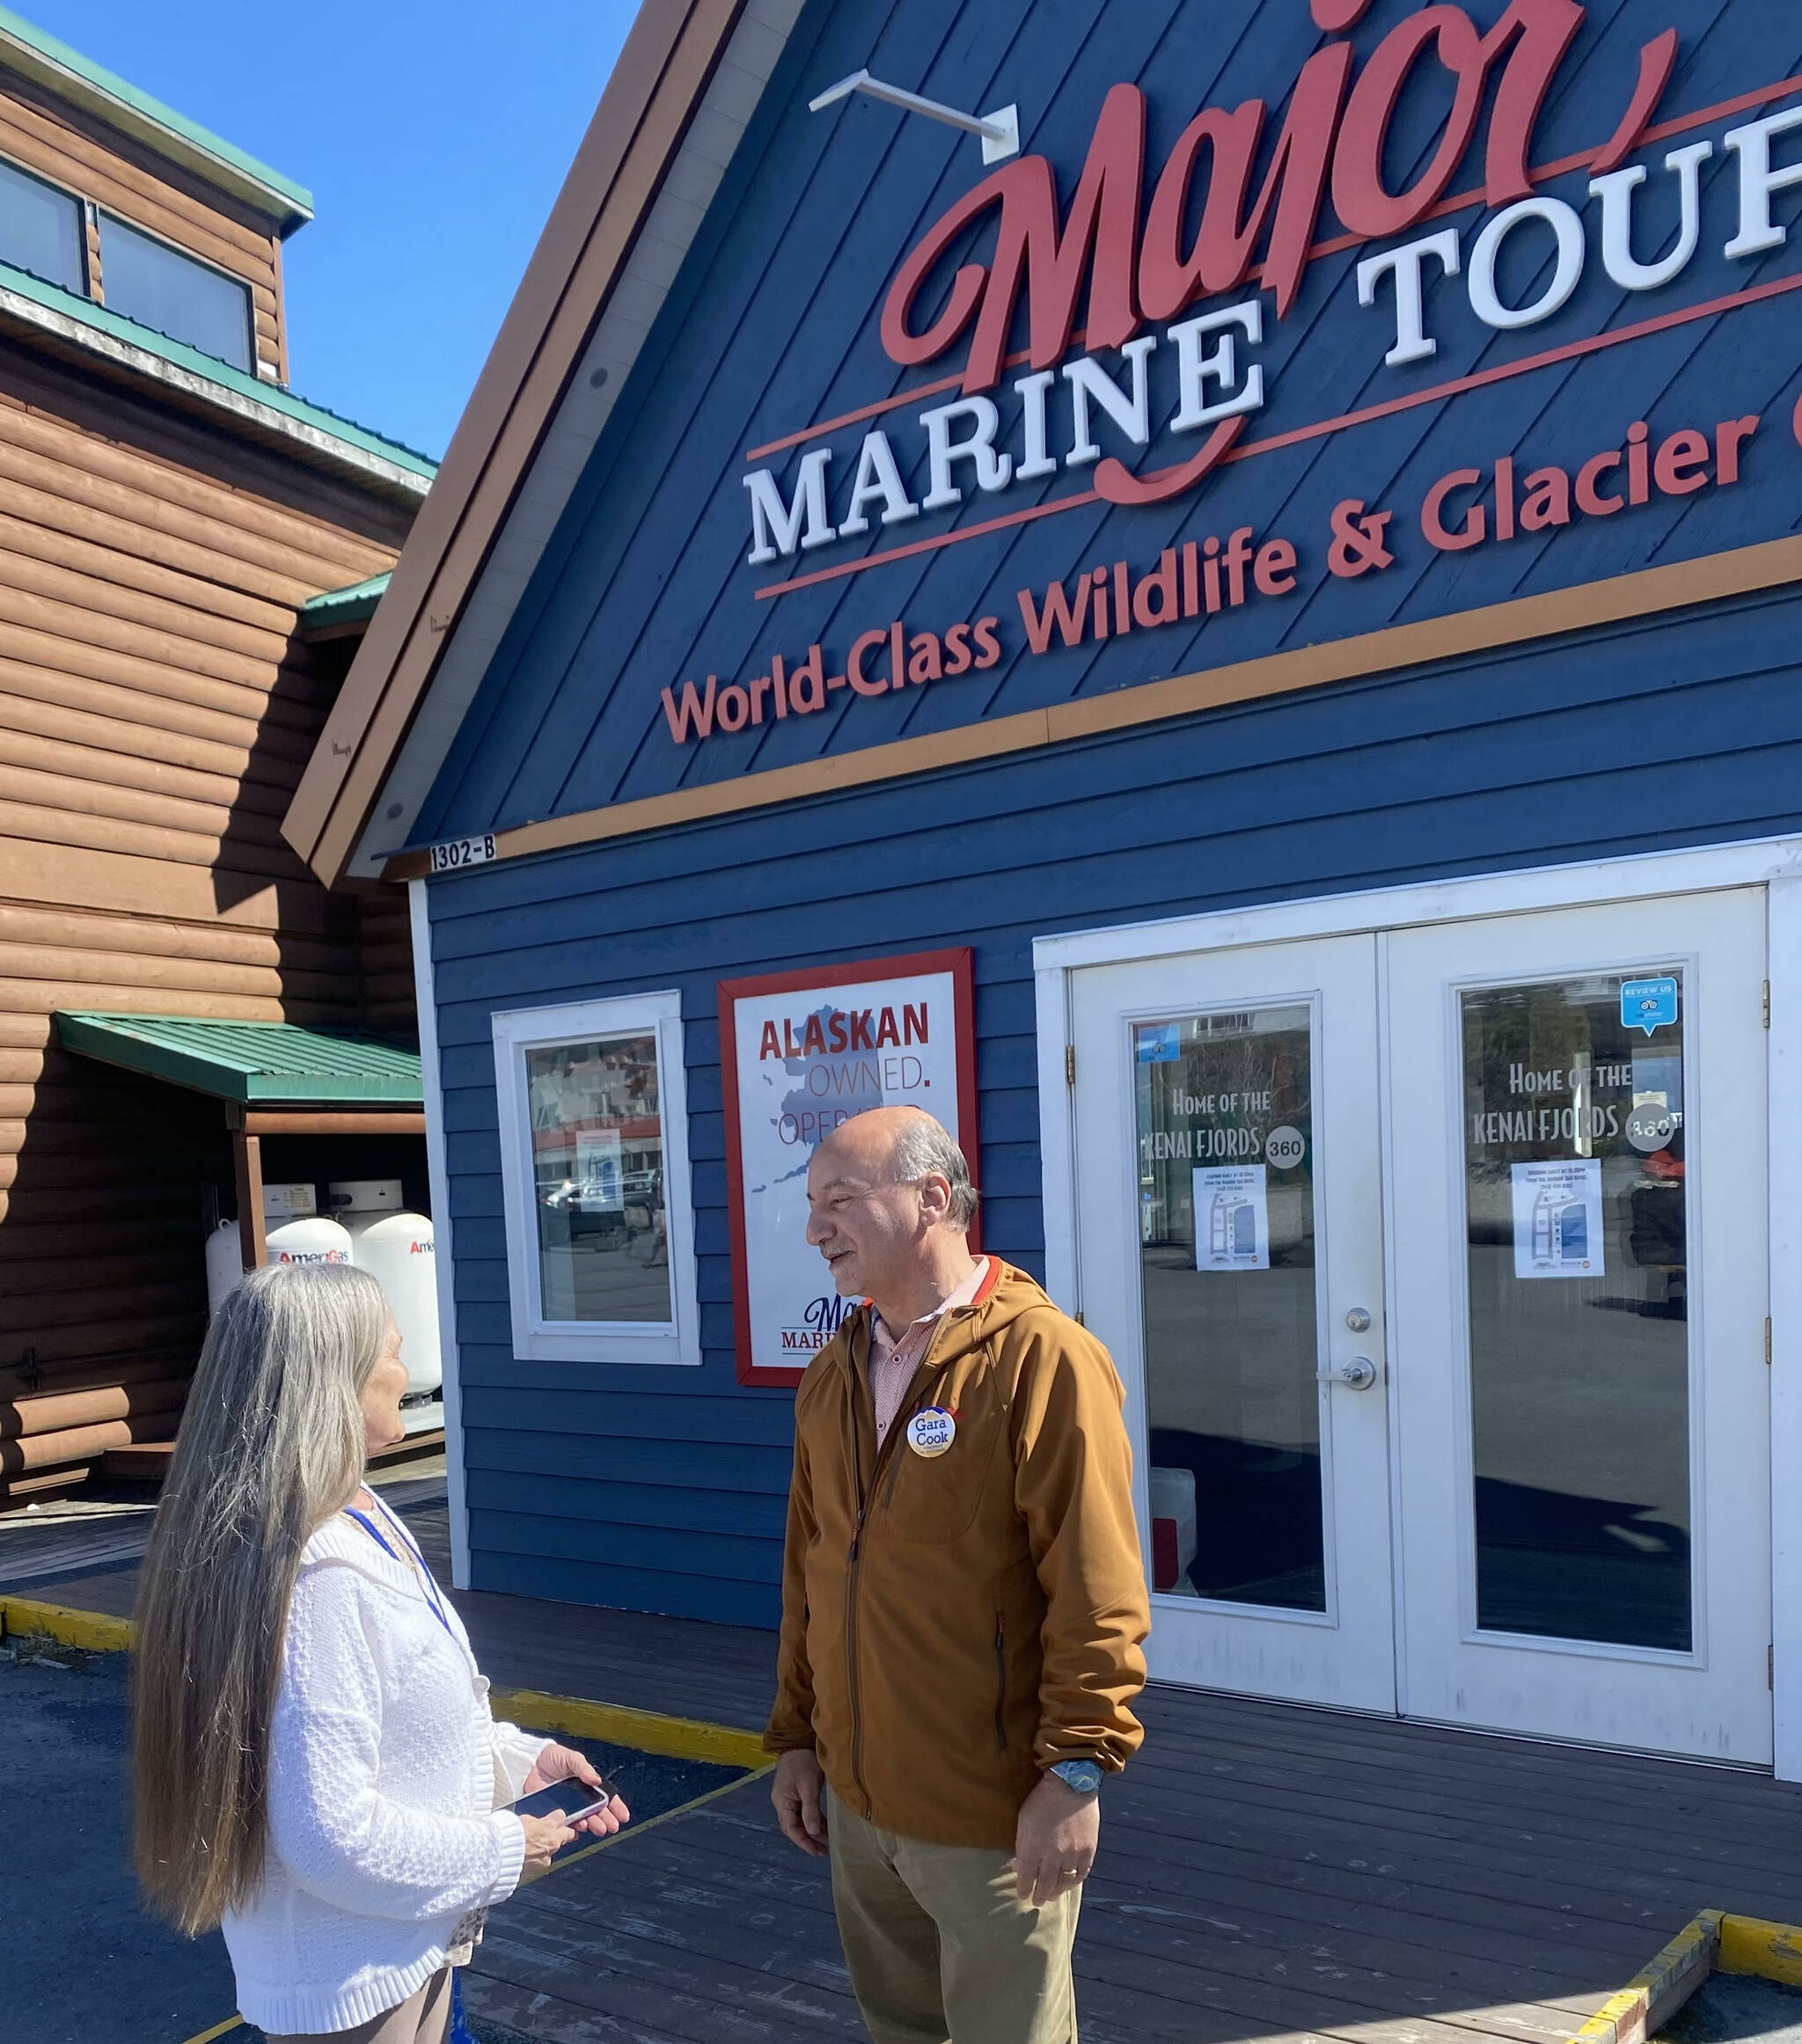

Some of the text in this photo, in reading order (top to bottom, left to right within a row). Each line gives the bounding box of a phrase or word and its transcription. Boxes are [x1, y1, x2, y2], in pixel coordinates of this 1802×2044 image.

[881, 0, 1676, 504] Major
[743, 299, 1263, 565] MARINE
[660, 616, 1000, 744] World-Class
[1016, 527, 1297, 655] Wildlife
[1326, 499, 1394, 578] &
[1421, 415, 1761, 551] Glacier
[431, 836, 494, 870] 1302-B
[1625, 986, 1658, 995] REVIEW
[759, 1002, 928, 1060] ALASKAN
[809, 1056, 930, 1097] OWNED.
[1595, 1064, 1632, 1087] THE
[1220, 1094, 1238, 1113] OF
[1242, 1091, 1271, 1112] THE
[1474, 1110, 1535, 1144] KENAI
[1538, 1104, 1619, 1141] FJORDS
[1145, 1127, 1301, 1160] KENAI FJORDS 360
[916, 1418, 947, 1432] Gara
[917, 1432, 948, 1446] Cook
